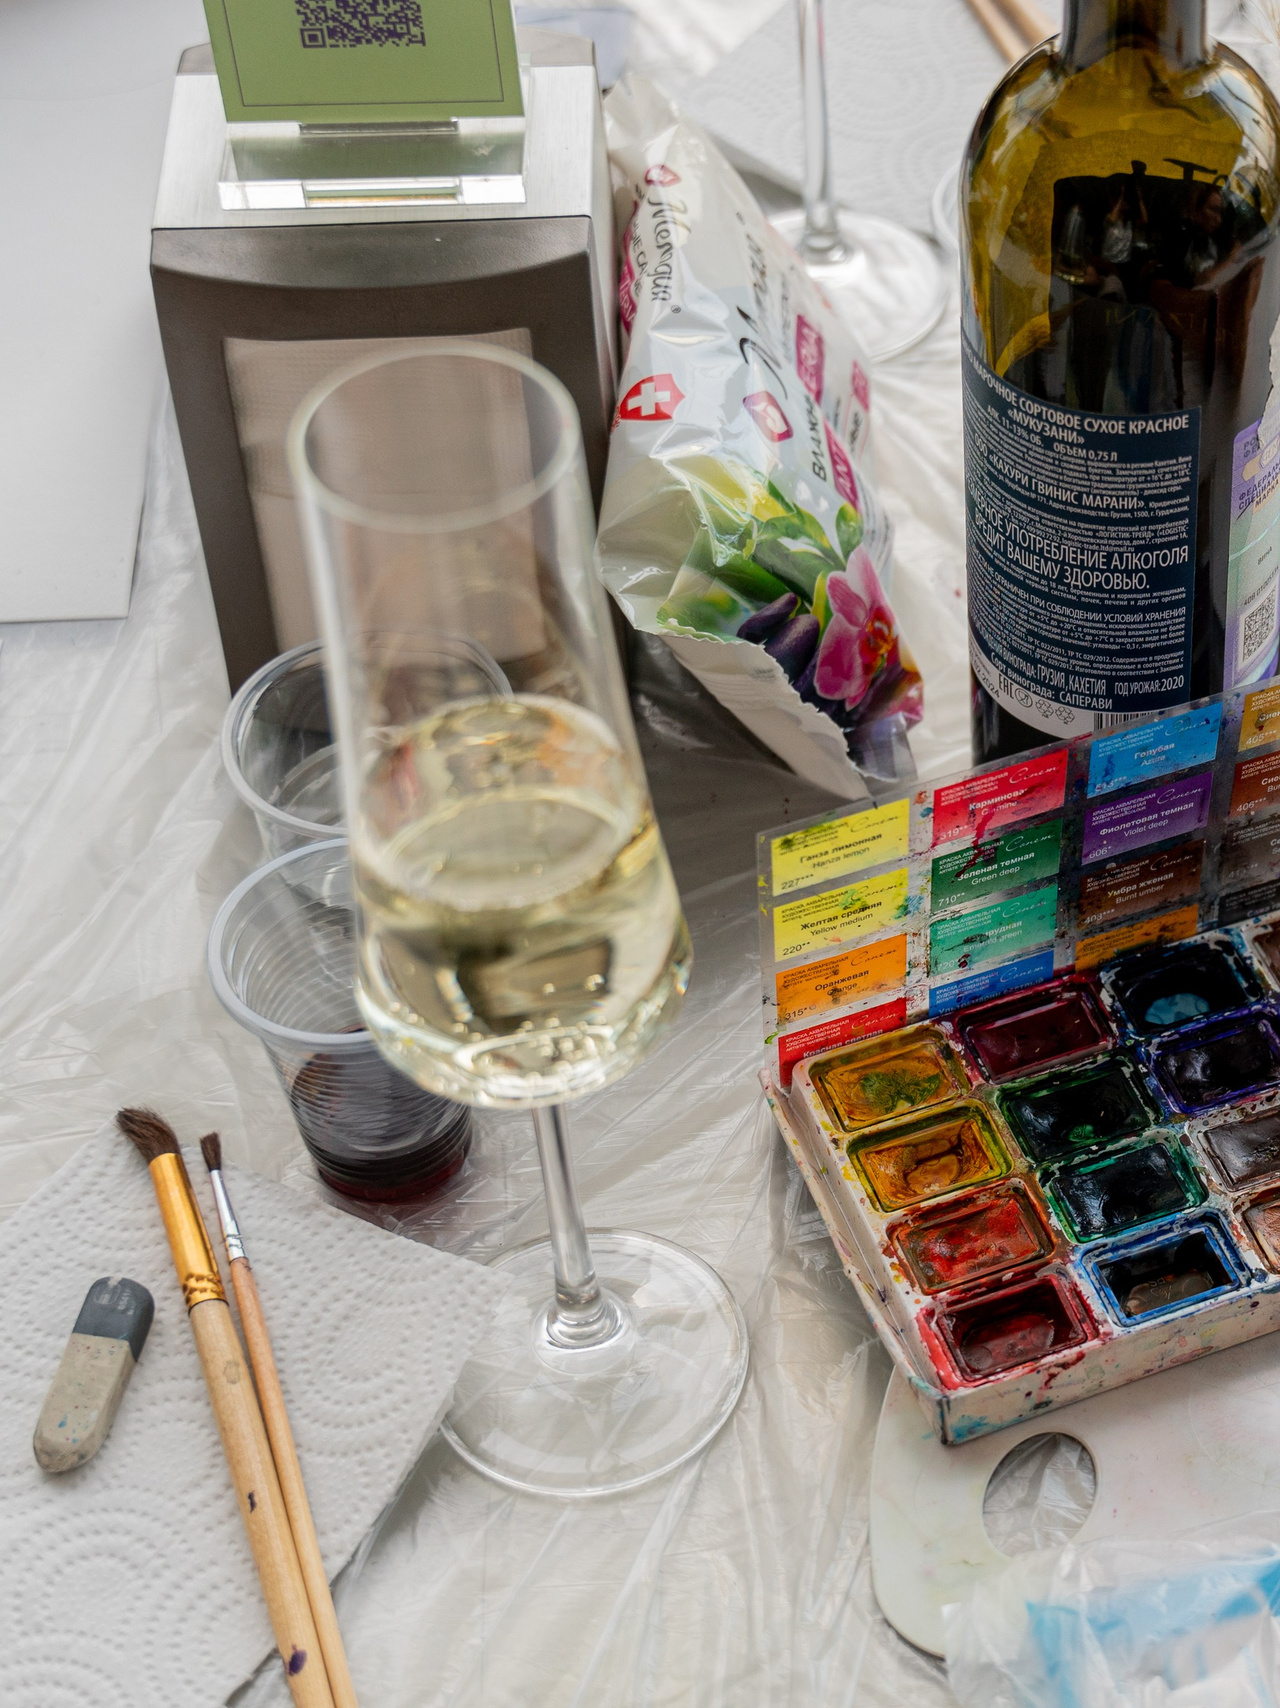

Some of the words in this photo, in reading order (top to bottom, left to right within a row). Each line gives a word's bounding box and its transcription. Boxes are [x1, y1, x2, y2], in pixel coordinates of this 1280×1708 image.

[1007, 408, 1085, 445] «МУКУЗАНИ»
[1019, 397, 1081, 430] СОРТОВОЕ
[1083, 417, 1126, 435] СУХОЕ
[1128, 414, 1190, 434] КРАСНОЕ
[1053, 442, 1087, 459] ОБЪЕМ
[1088, 450, 1109, 461] 0,75
[1110, 451, 1118, 462] Л
[989, 453, 1029, 488] «КАХУРИ
[1032, 478, 1079, 505] ГВИНИС
[1134, 510, 1150, 518] 1500,
[1005, 519, 1108, 569] УПОТРЕБЛЕНИЕ
[1111, 545, 1189, 570] АЛКОГОЛЯ
[1007, 541, 1061, 579] ВАШЕМУ
[1063, 565, 1150, 590] ЗДОРОВЬЮ.
[1049, 580, 1057, 588] 18
[1030, 594, 1045, 608] ПРИ
[1046, 602, 1102, 621] СОБЛЮДЕНИИ
[1103, 611, 1143, 622] УСЛОВИЙ
[1145, 606, 1186, 621] ХРАНЕНИЯ
[1080, 596, 1102, 605] почек,
[1136, 598, 1159, 606] других
[1161, 593, 1186, 602] органов
[1168, 623, 1186, 632] более
[1168, 630, 1186, 638] более
[1083, 653, 1112, 663] 029/2012.
[991, 652, 1006, 673] Сорт
[1007, 668, 1055, 699] винограда:
[1059, 690, 1113, 710] САПЕРАВИ
[1037, 664, 1069, 692] ГРУЗИЯ,
[1069, 674, 1107, 696] КАХЕТИЯ
[1114, 681, 1129, 697] ГОД
[1134, 743, 1176, 759] Голубая
[1140, 754, 1166, 767] Azure
[1100, 813, 1158, 836] Фиолетовая
[1160, 802, 1194, 817] темная
[1123, 824, 1147, 837] Violet
[1148, 819, 1169, 831] deep
[800, 850, 829, 863] Ганза
[831, 833, 883, 854] лимонная
[812, 855, 841, 869] Hanza
[843, 846, 870, 860] lemon
[957, 864, 998, 881] Зеленая
[1000, 852, 1035, 868] темная
[971, 873, 998, 886] Green
[999, 866, 1021, 878] deep
[1107, 884, 1137, 898] Умбра
[1138, 872, 1174, 889] жженая
[1116, 891, 1138, 904] Burnt
[1139, 884, 1165, 897] umber
[800, 914, 839, 931] Желтая
[840, 901, 883, 919] средняя
[810, 925, 838, 937] Yellow
[840, 913, 874, 928] medium
[1000, 930, 1023, 942] green
[815, 969, 870, 991] Оранжевая
